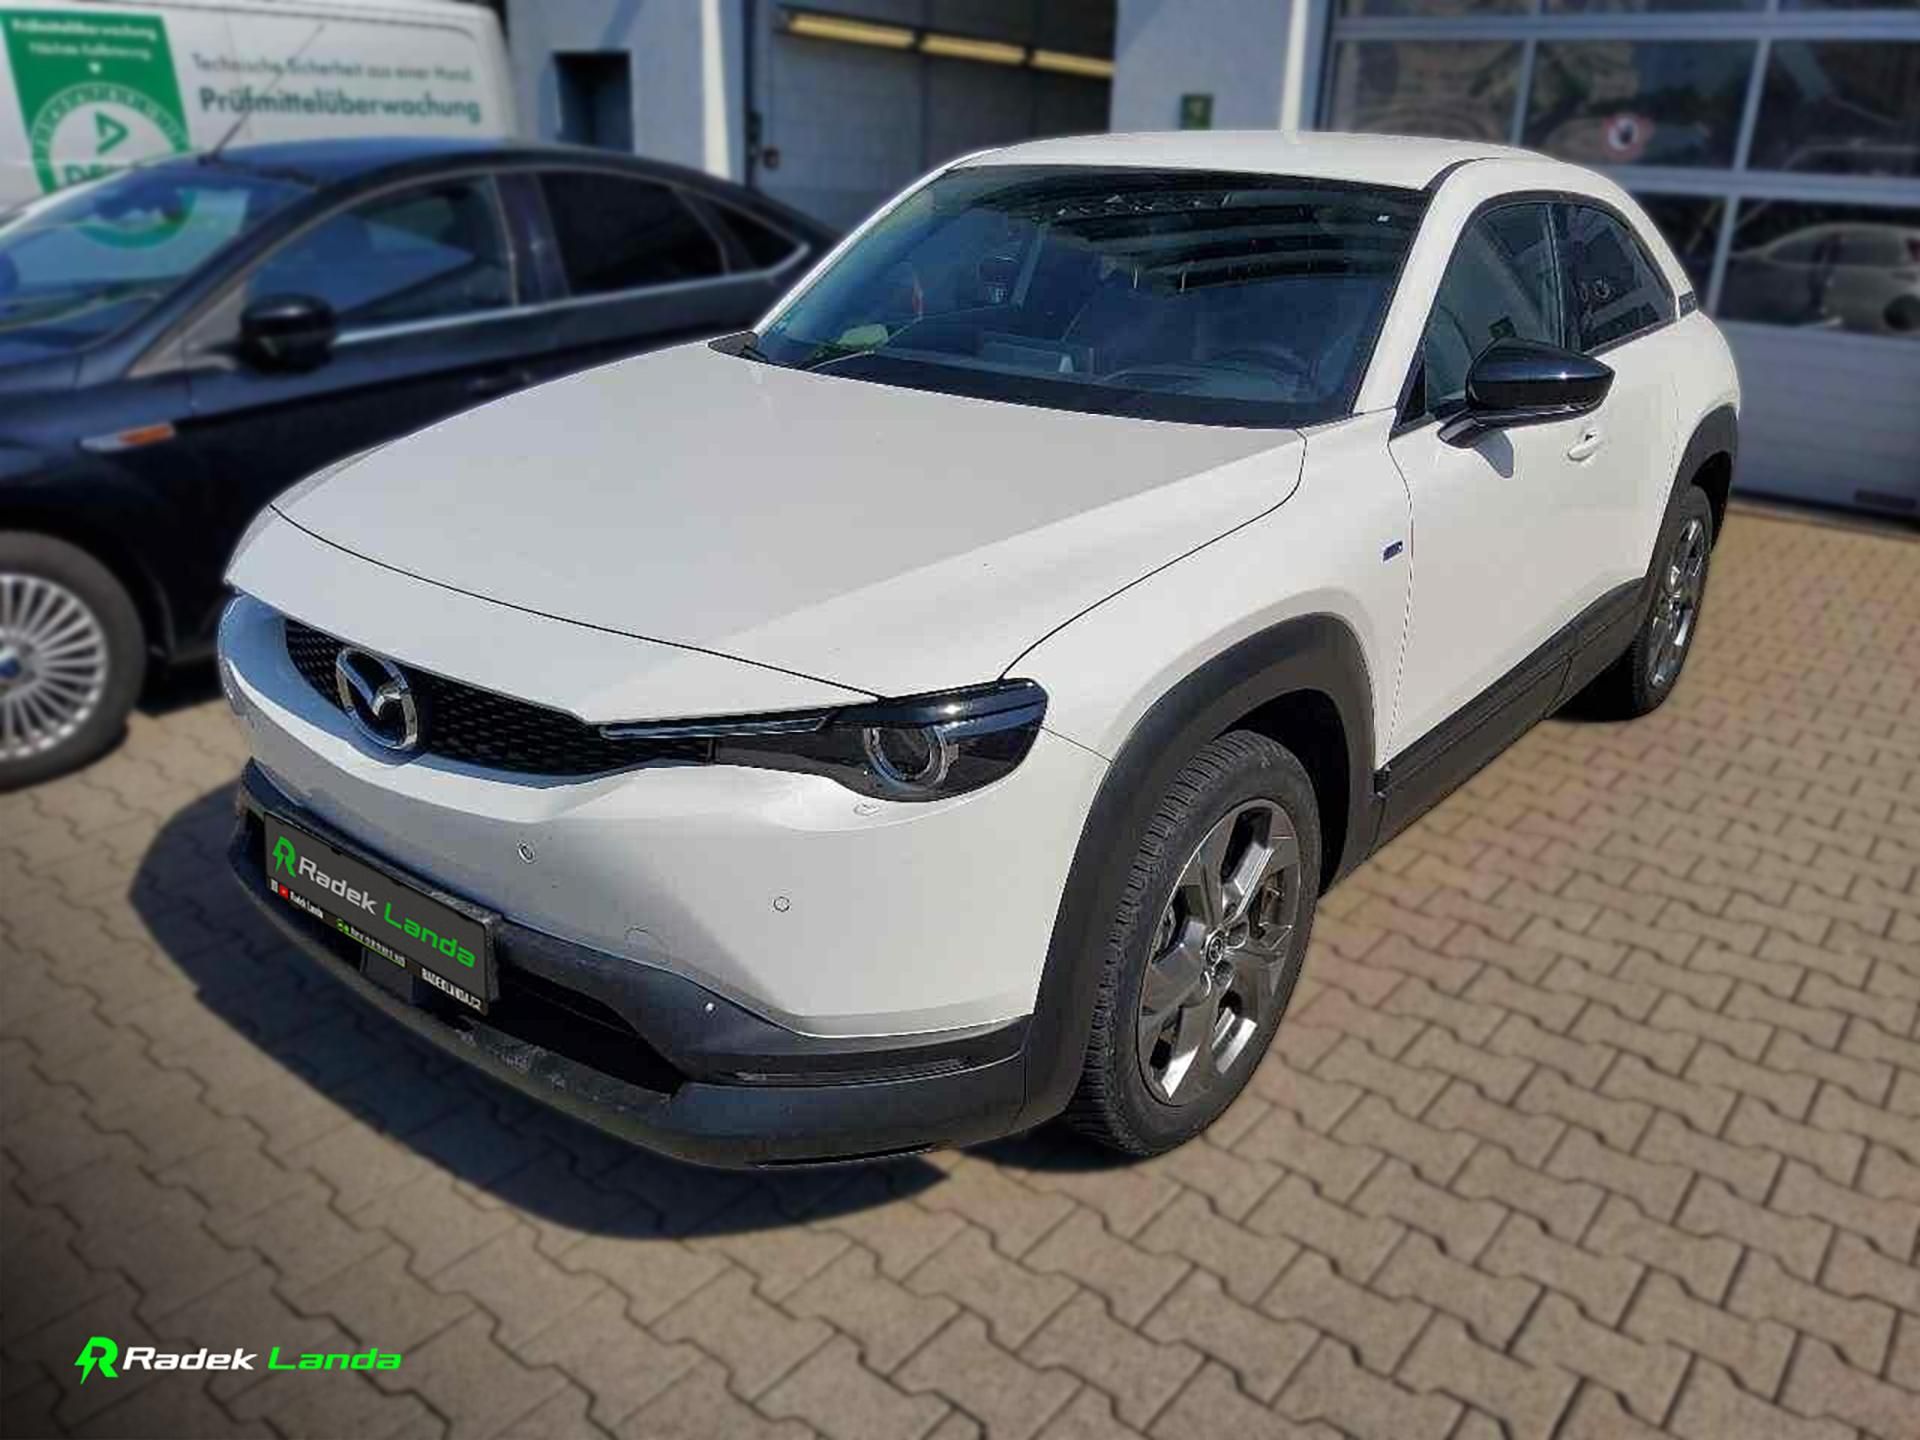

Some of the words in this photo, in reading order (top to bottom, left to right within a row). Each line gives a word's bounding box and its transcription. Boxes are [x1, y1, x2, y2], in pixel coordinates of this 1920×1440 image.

[192, 52, 284, 76] Technische
[286, 58, 362, 76] Sicherheit
[198, 84, 482, 125] Prüfmittelüberwachung
